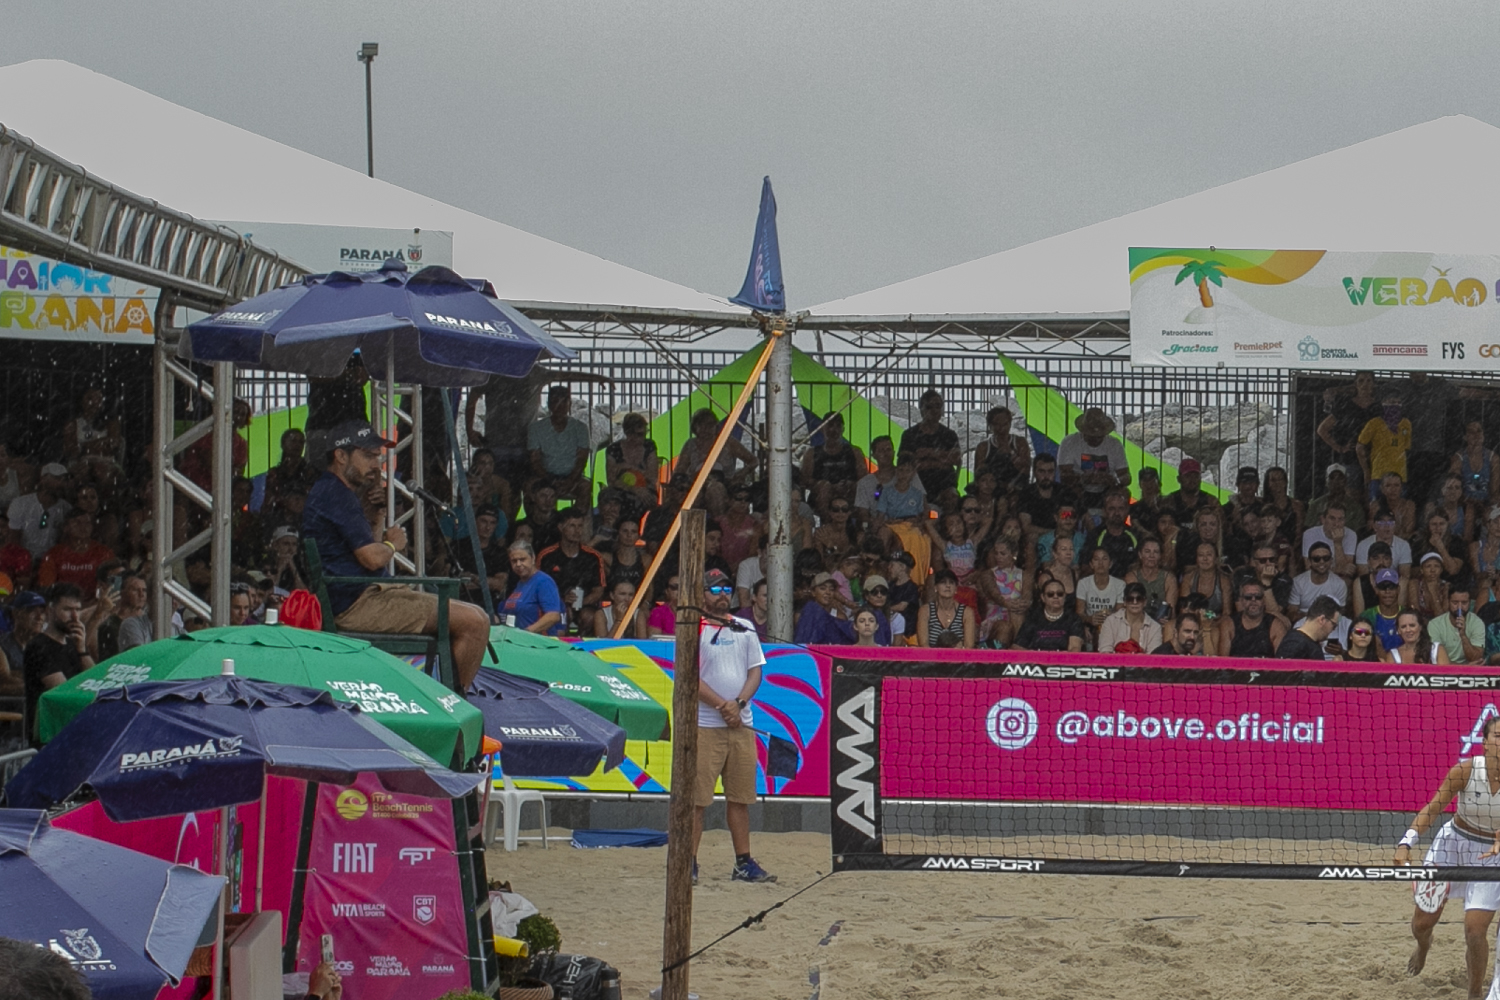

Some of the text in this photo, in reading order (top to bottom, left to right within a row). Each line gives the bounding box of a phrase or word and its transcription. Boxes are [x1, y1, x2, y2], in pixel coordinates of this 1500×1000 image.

[0, 260, 111, 294] AIOR
[1342, 265, 1488, 307] VERÃO
[1162, 343, 1219, 356] graciosa
[1373, 346, 1428, 355] americanas
[1442, 342, 1465, 359] FYS
[1056, 710, 1325, 744] @above.oficial
[121, 739, 217, 766] PARANÁ
[837, 686, 876, 839] AMA
[333, 843, 377, 873] FIAT
[399, 847, 435, 865] FPT
[422, 964, 455, 972] PARANÁ
